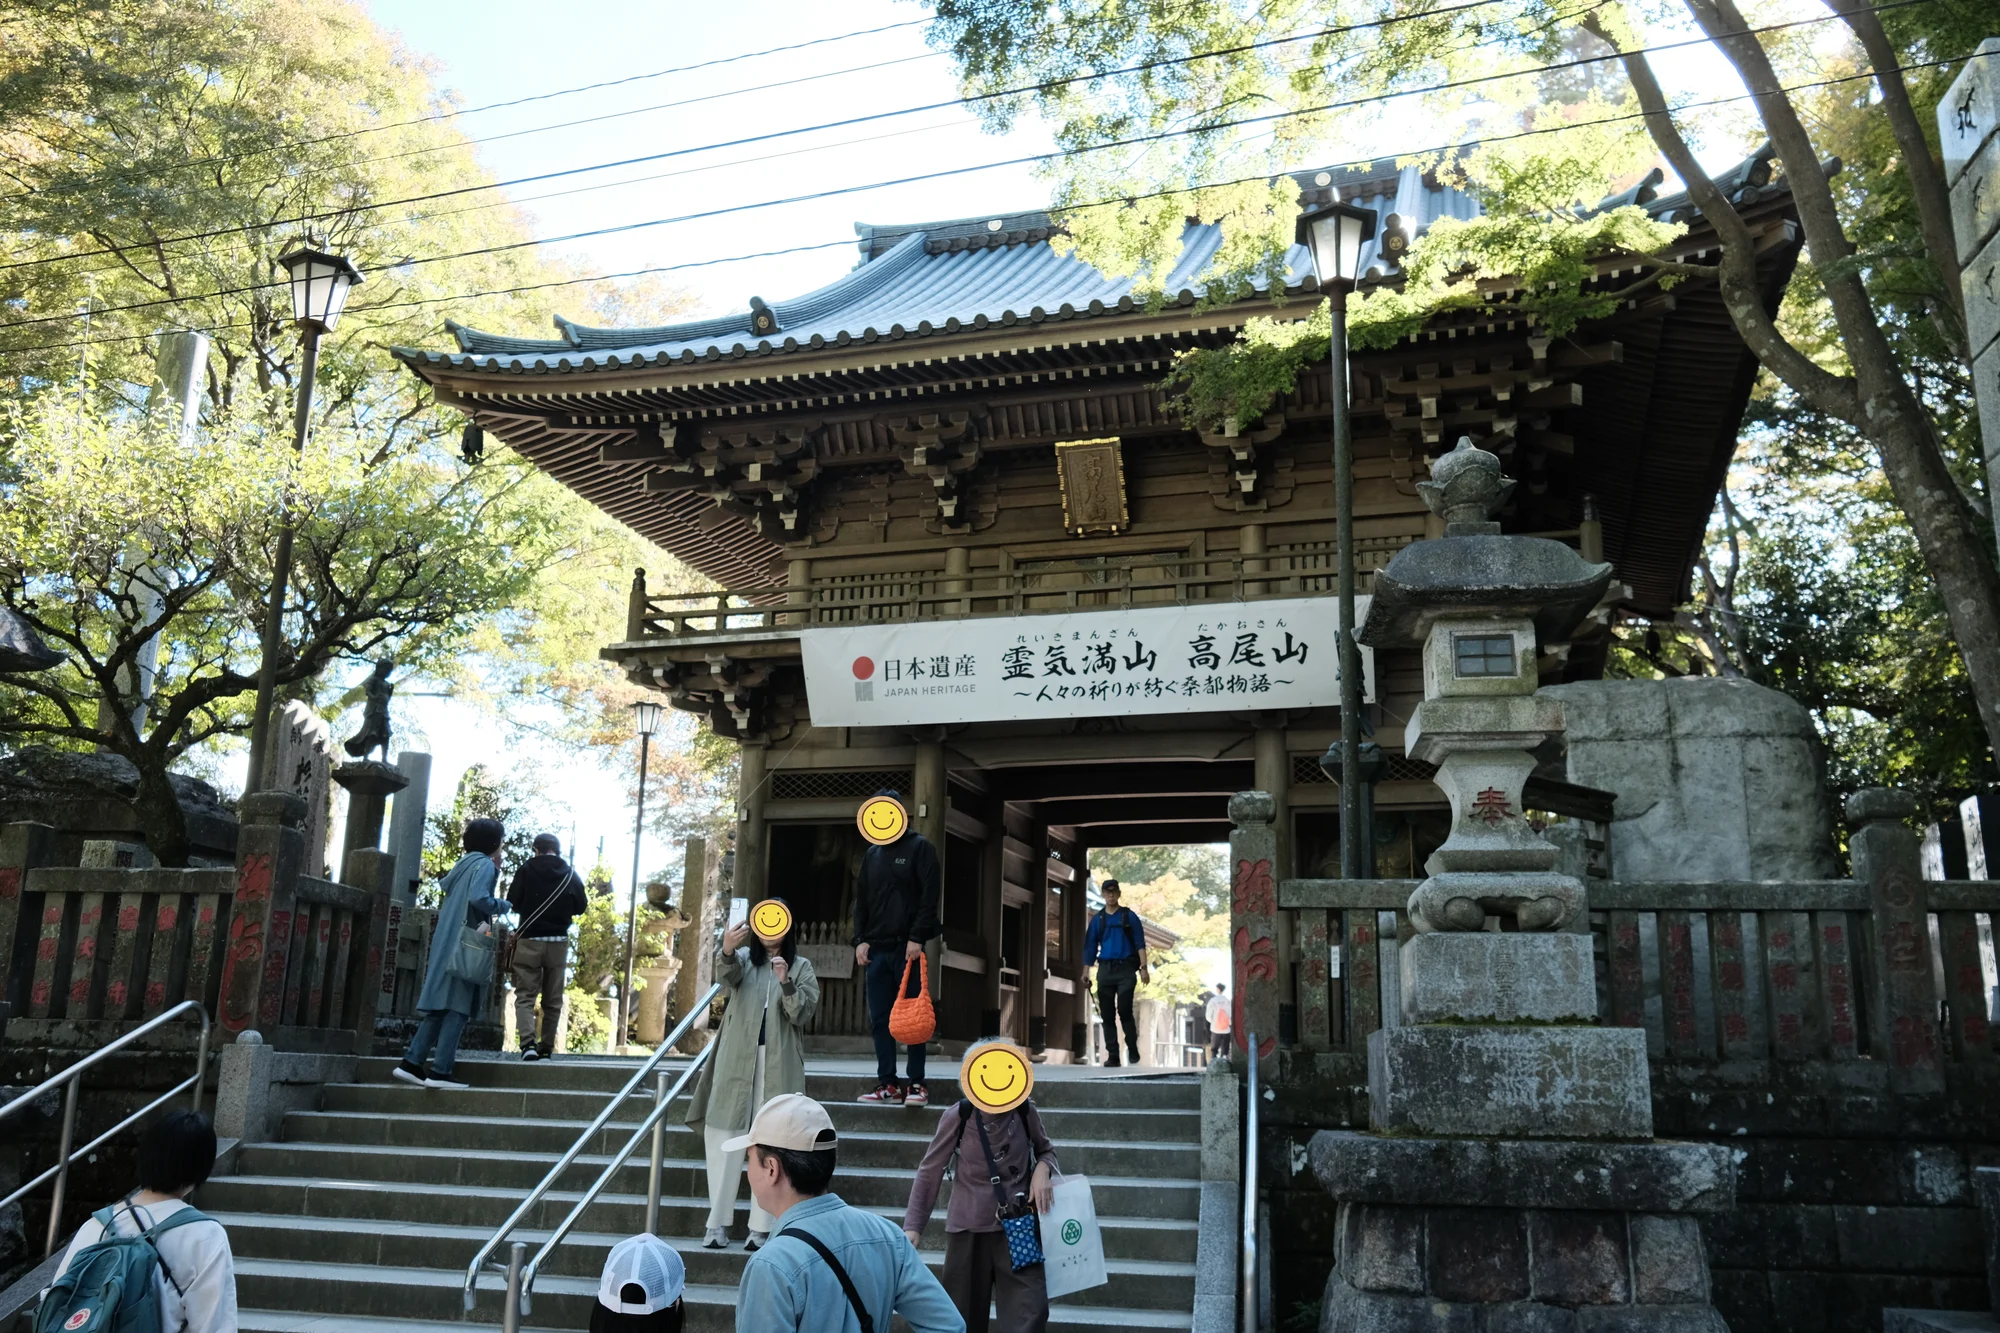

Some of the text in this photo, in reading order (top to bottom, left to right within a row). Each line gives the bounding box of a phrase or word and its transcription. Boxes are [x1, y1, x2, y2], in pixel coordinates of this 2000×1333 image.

[1197, 617, 1288, 632] たかおさん
[884, 653, 976, 682] 日本遺産
[1001, 631, 1309, 682] 霊気満山 高尾山
[884, 684, 976, 698] JAPAN HERITAGE
[1468, 786, 1517, 830] 奉
